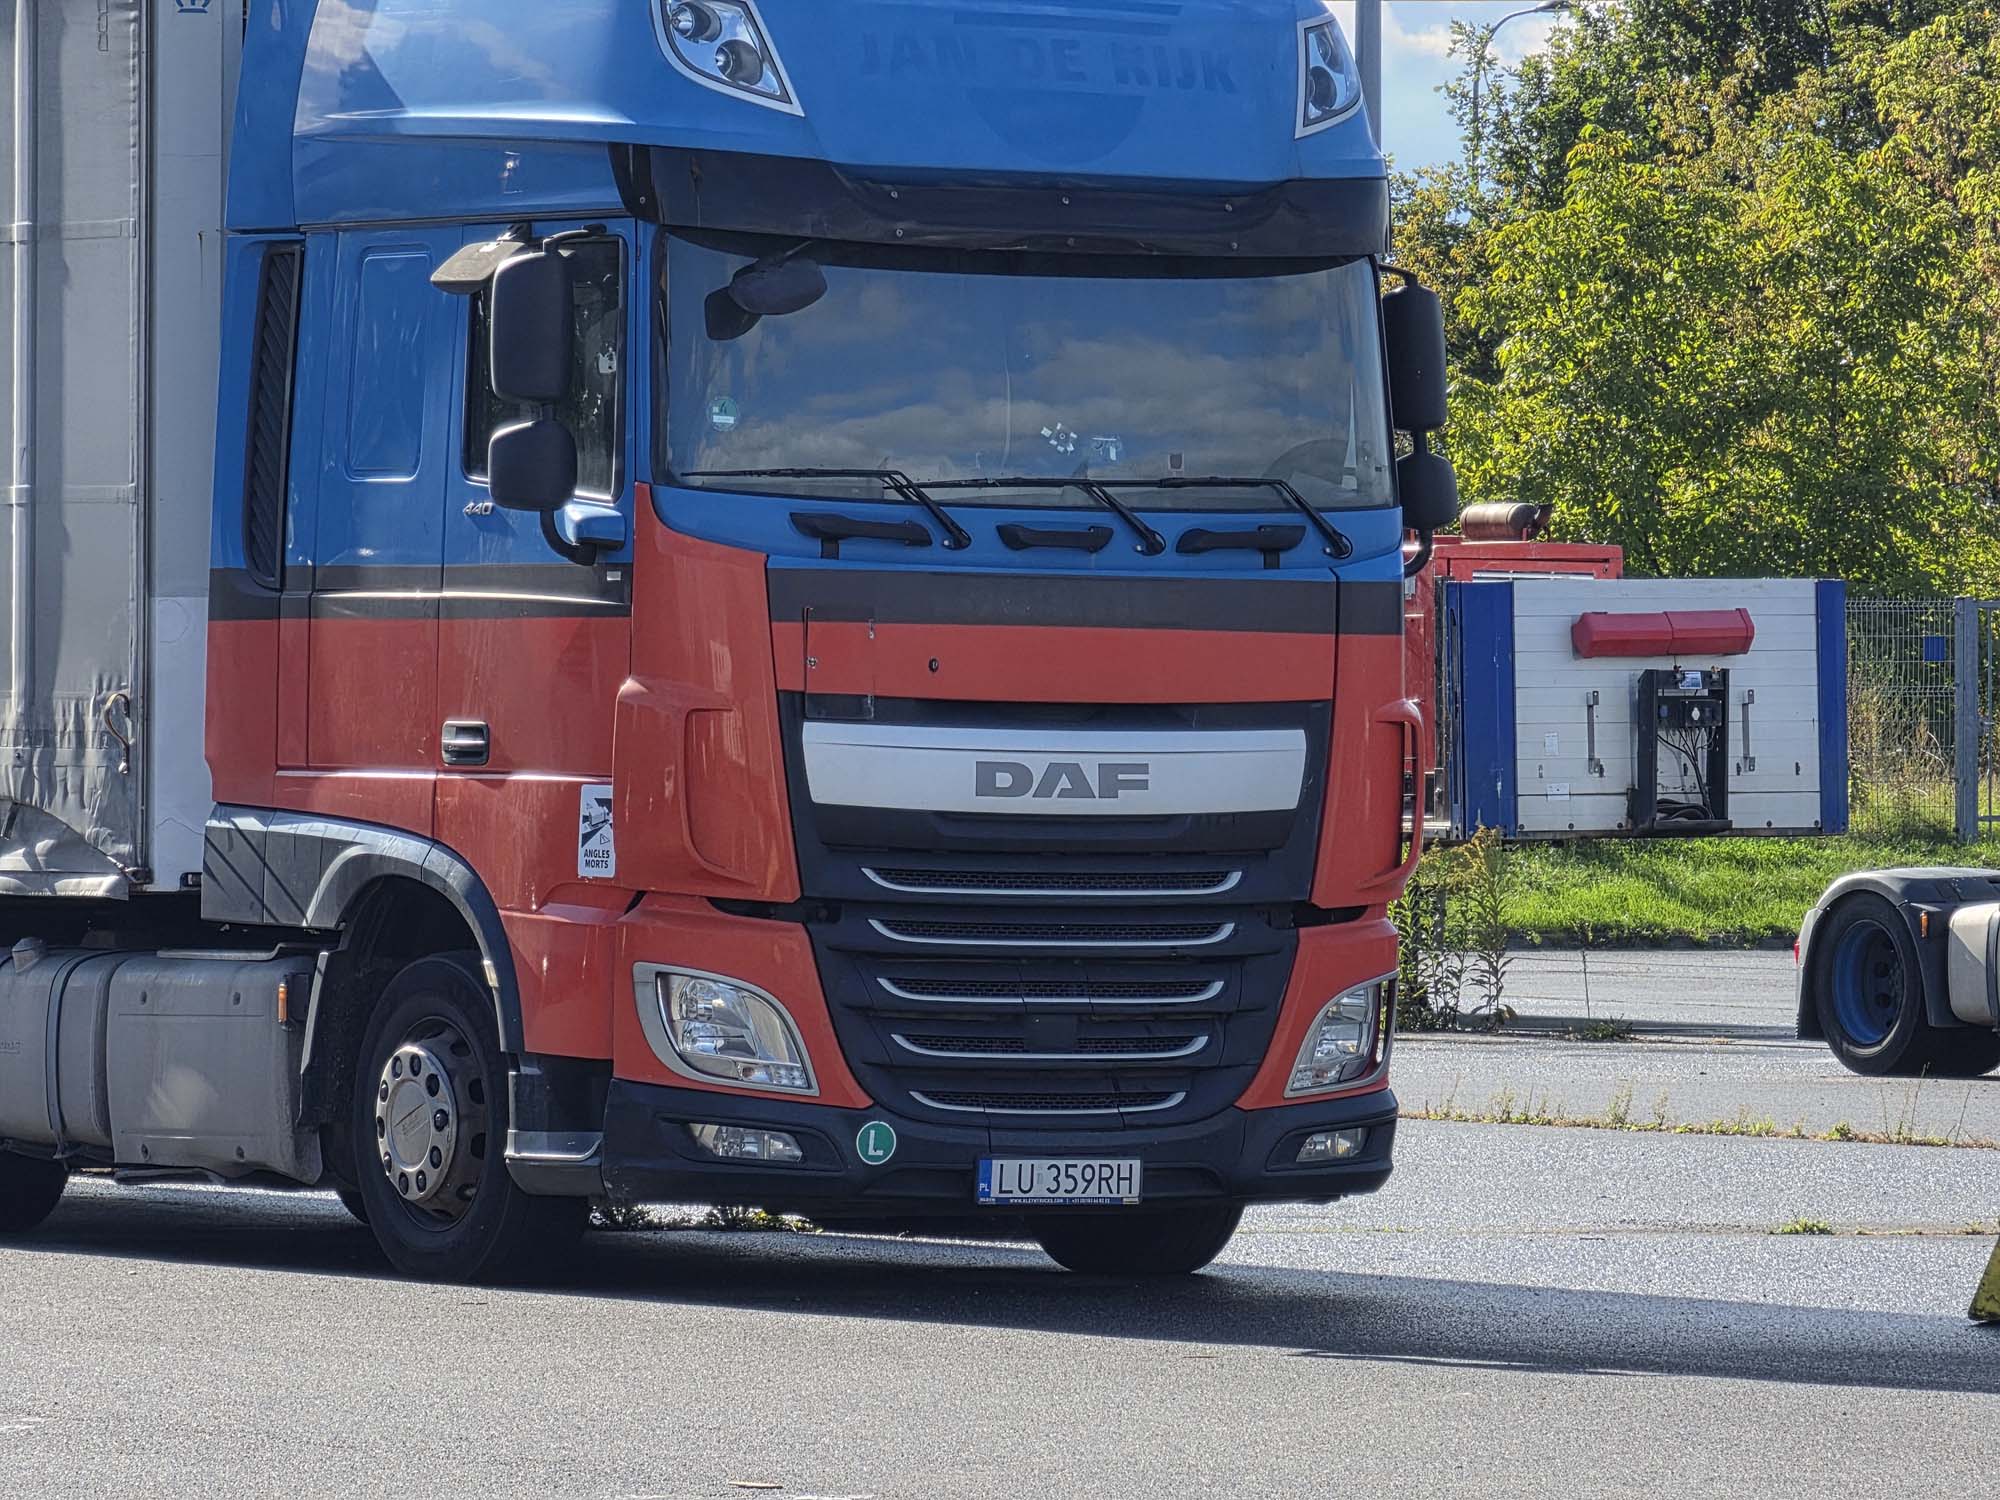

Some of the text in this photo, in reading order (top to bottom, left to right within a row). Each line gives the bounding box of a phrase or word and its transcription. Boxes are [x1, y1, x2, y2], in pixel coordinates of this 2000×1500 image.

[1004, 37, 1087, 82] DE
[462, 501, 493, 515] 440
[976, 760, 1150, 799] DAF
[583, 848, 610, 859] ANGLES
[584, 859, 609, 869] MORTS
[868, 1129, 884, 1156] L
[979, 1183, 990, 1192] PL
[998, 1163, 1133, 1195] LU 359RH
